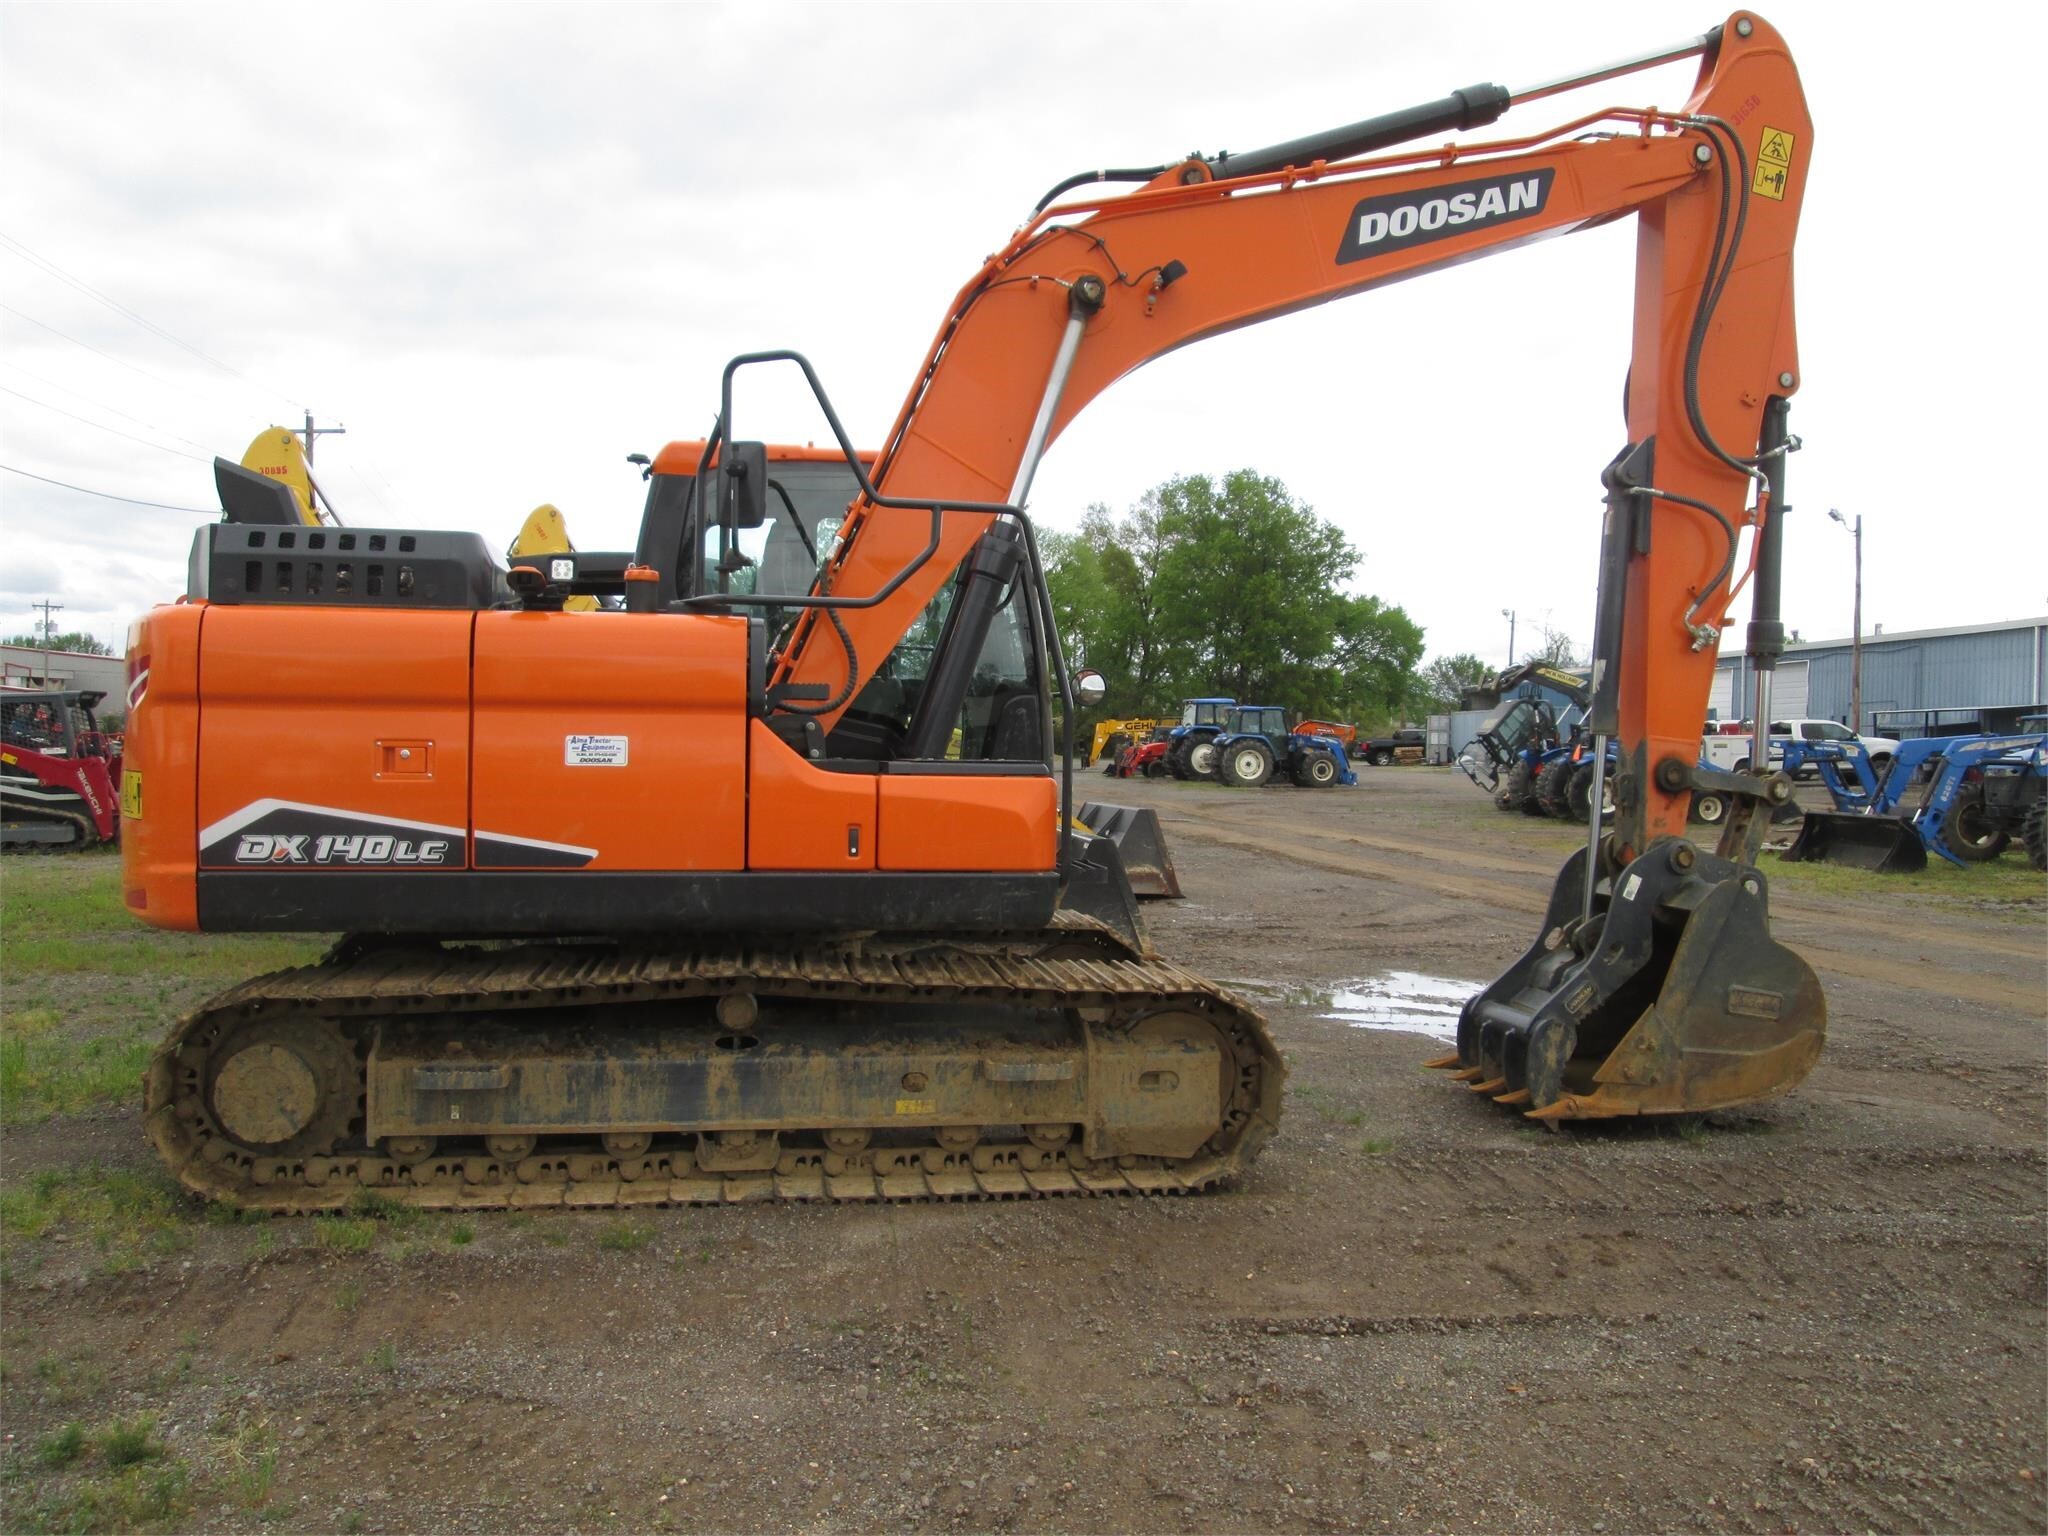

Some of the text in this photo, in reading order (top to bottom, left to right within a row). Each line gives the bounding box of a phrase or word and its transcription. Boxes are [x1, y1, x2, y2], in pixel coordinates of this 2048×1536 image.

[1358, 178, 1539, 245] DOOSAN
[581, 744, 616, 752] Equipment
[588, 736, 611, 744] Tractor
[235, 835, 311, 863] DX
